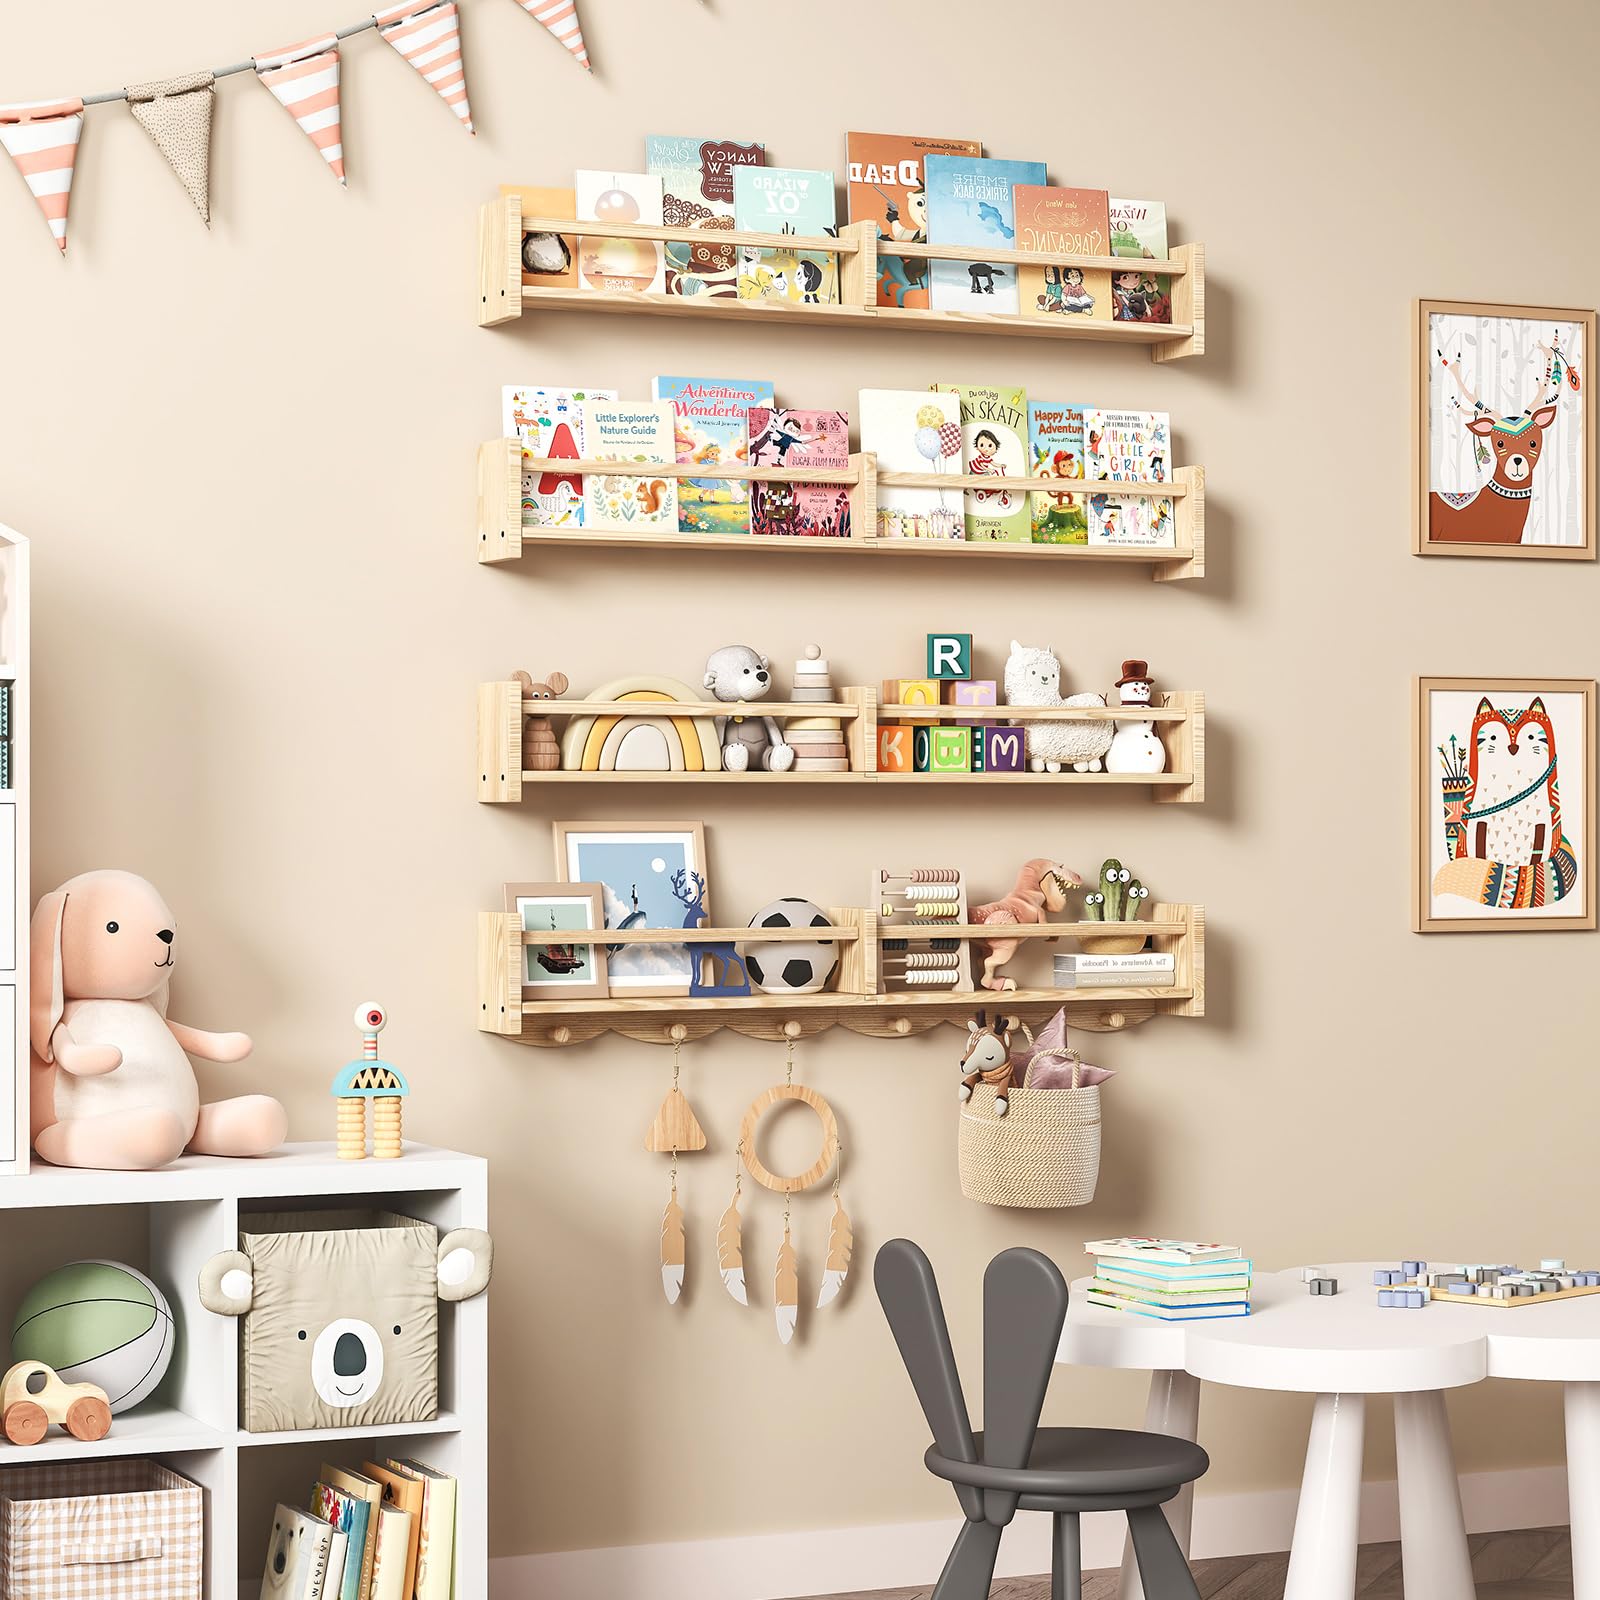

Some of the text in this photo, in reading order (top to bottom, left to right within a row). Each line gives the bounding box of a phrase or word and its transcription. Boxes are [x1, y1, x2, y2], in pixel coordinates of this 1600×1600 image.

[676, 383, 756, 400] Adventures
[968, 390, 978, 398] Du
[986, 391, 999, 400] jag
[670, 400, 747, 418] Wonderla
[715, 398, 724, 406] in
[595, 413, 660, 425] Little Explorer's
[978, 400, 1024, 428] SKATT
[1034, 408, 1084, 423] Happy Jun
[600, 425, 657, 435] Nature Guide
[1038, 422, 1084, 436] Adventur
[792, 456, 812, 466] SUGAR
[933, 638, 964, 675] R
[880, 730, 904, 768] K
[991, 733, 1019, 767] M
